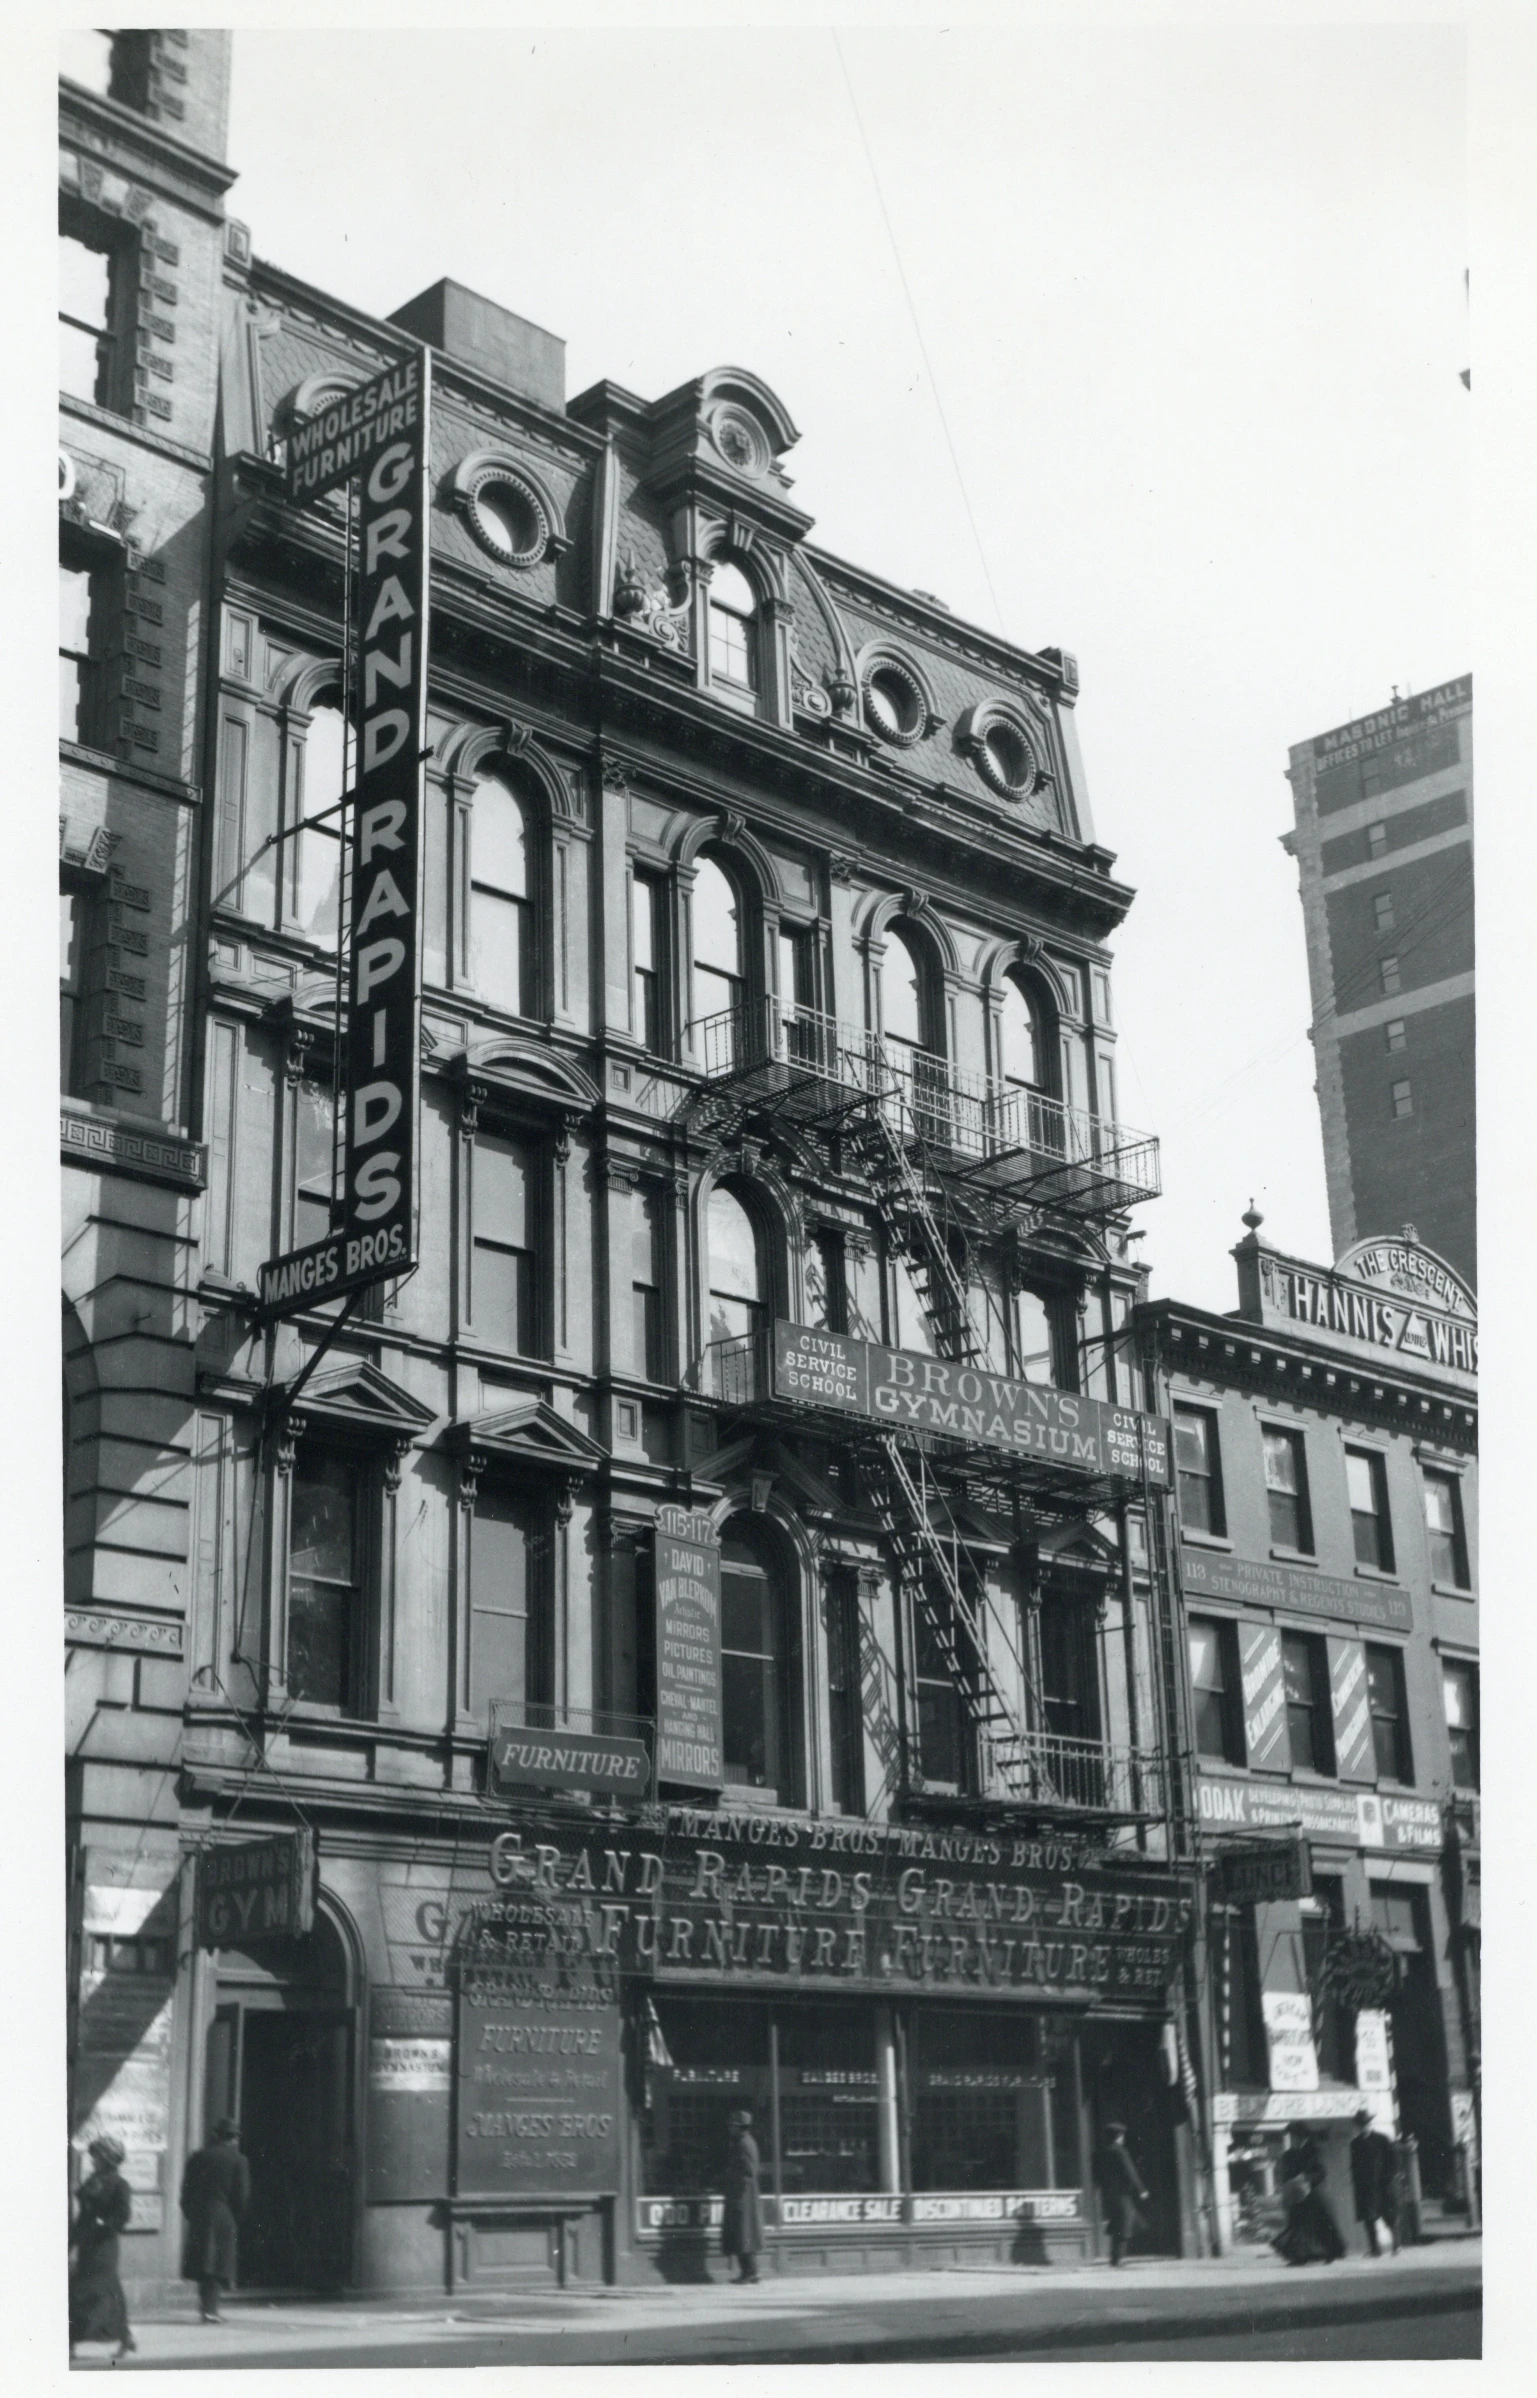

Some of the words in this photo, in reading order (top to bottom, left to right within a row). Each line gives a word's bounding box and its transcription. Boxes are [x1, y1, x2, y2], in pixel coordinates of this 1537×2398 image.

[292, 360, 418, 460] WHOLESALE
[293, 395, 418, 497] FURNITURE
[364, 442, 416, 776] GRAND
[1323, 704, 1409, 751] MASONIC
[1420, 683, 1467, 713] HALL
[1316, 744, 1360, 772] OFFICES
[1374, 729, 1393, 748] LET
[354, 800, 412, 1221] RAPIDS
[265, 1247, 338, 1306] MANGES
[346, 1224, 406, 1276] BROS.
[1354, 1250, 1389, 1280] THE
[1390, 1249, 1465, 1312] CRESCENT
[1292, 1275, 1397, 1348] HANNIS
[785, 1351, 857, 1382] SERVICE
[799, 1335, 847, 1361] CIVIL
[788, 1370, 857, 1401] SCHOOL
[887, 1354, 1080, 1429] BROWN'S
[875, 1386, 1097, 1462] GYMNASIUM
[671, 1548, 704, 1577] DAVID
[1237, 1563, 1284, 1586] PRIVATE
[1288, 1572, 1360, 1598] INSTRUCTION
[659, 1577, 677, 1612] VAN
[1211, 1575, 1287, 1603] STENOGRAPHY
[665, 1618, 710, 1643] MIRRORS
[664, 1640, 713, 1665] PICTURES
[662, 1661, 676, 1680] OIL
[676, 1664, 717, 1688] PAINTINGS
[501, 1743, 641, 1780] FURNITURE
[660, 1739, 720, 1777] MIRRORS
[1193, 1785, 1247, 1823] ODAK
[1382, 1798, 1440, 1825] CAMERAS
[678, 1812, 800, 1848] MANGES
[897, 1831, 1002, 1867] MANGES
[489, 1832, 665, 1896] GRAND
[690, 1849, 872, 1912] RAPIDS
[208, 1883, 289, 1937] GYM
[899, 1866, 1036, 1924] GRAND
[1056, 1881, 1194, 1935] RAPIDS
[471, 1901, 595, 1928] WHOLESALE
[596, 1904, 866, 1970] FURNITURE
[888, 1925, 1111, 1984] FURNITURE
[481, 2024, 602, 2055] FURNITURE
[783, 2200, 863, 2224] CLEARANCE
[864, 2199, 902, 2221] SALE
